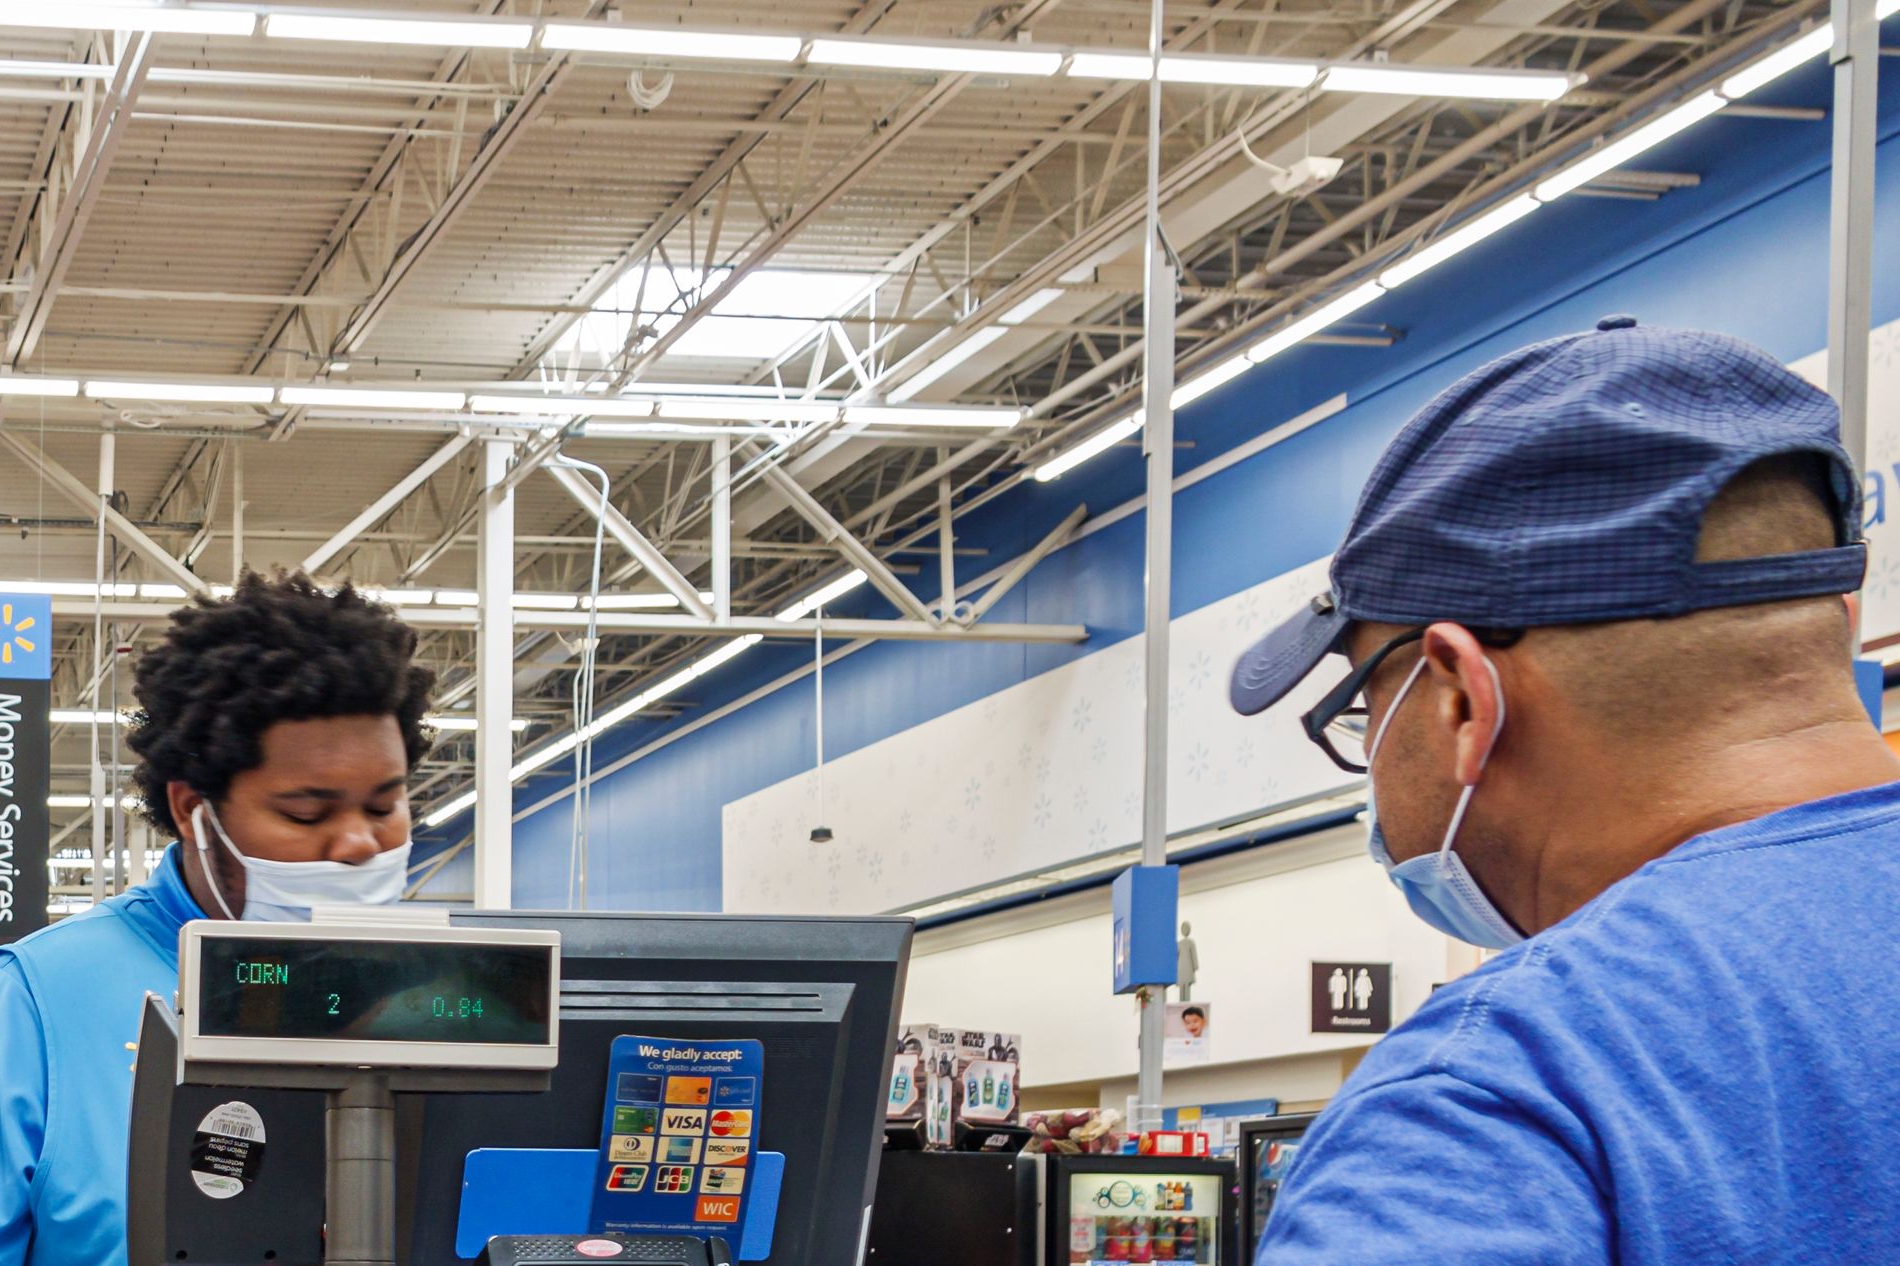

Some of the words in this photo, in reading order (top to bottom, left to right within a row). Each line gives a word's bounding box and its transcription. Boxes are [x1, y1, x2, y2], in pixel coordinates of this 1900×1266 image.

[236, 963, 288, 984] CORN
[328, 994, 340, 1014] 2
[433, 996, 484, 1018] 0.84
[1330, 1015, 1371, 1026] Restrooms
[964, 1032, 985, 1040] STAR
[962, 1038, 986, 1048] WARS
[640, 1045, 660, 1058] We
[662, 1047, 700, 1062] gladly
[703, 1050, 743, 1062] accept:
[648, 1062, 664, 1070] Con
[666, 1063, 690, 1073] gusto
[667, 1116, 703, 1130] VISA
[708, 1144, 746, 1153] DISCOVER
[658, 1174, 690, 1184] JCB
[704, 1202, 734, 1216] WIC
